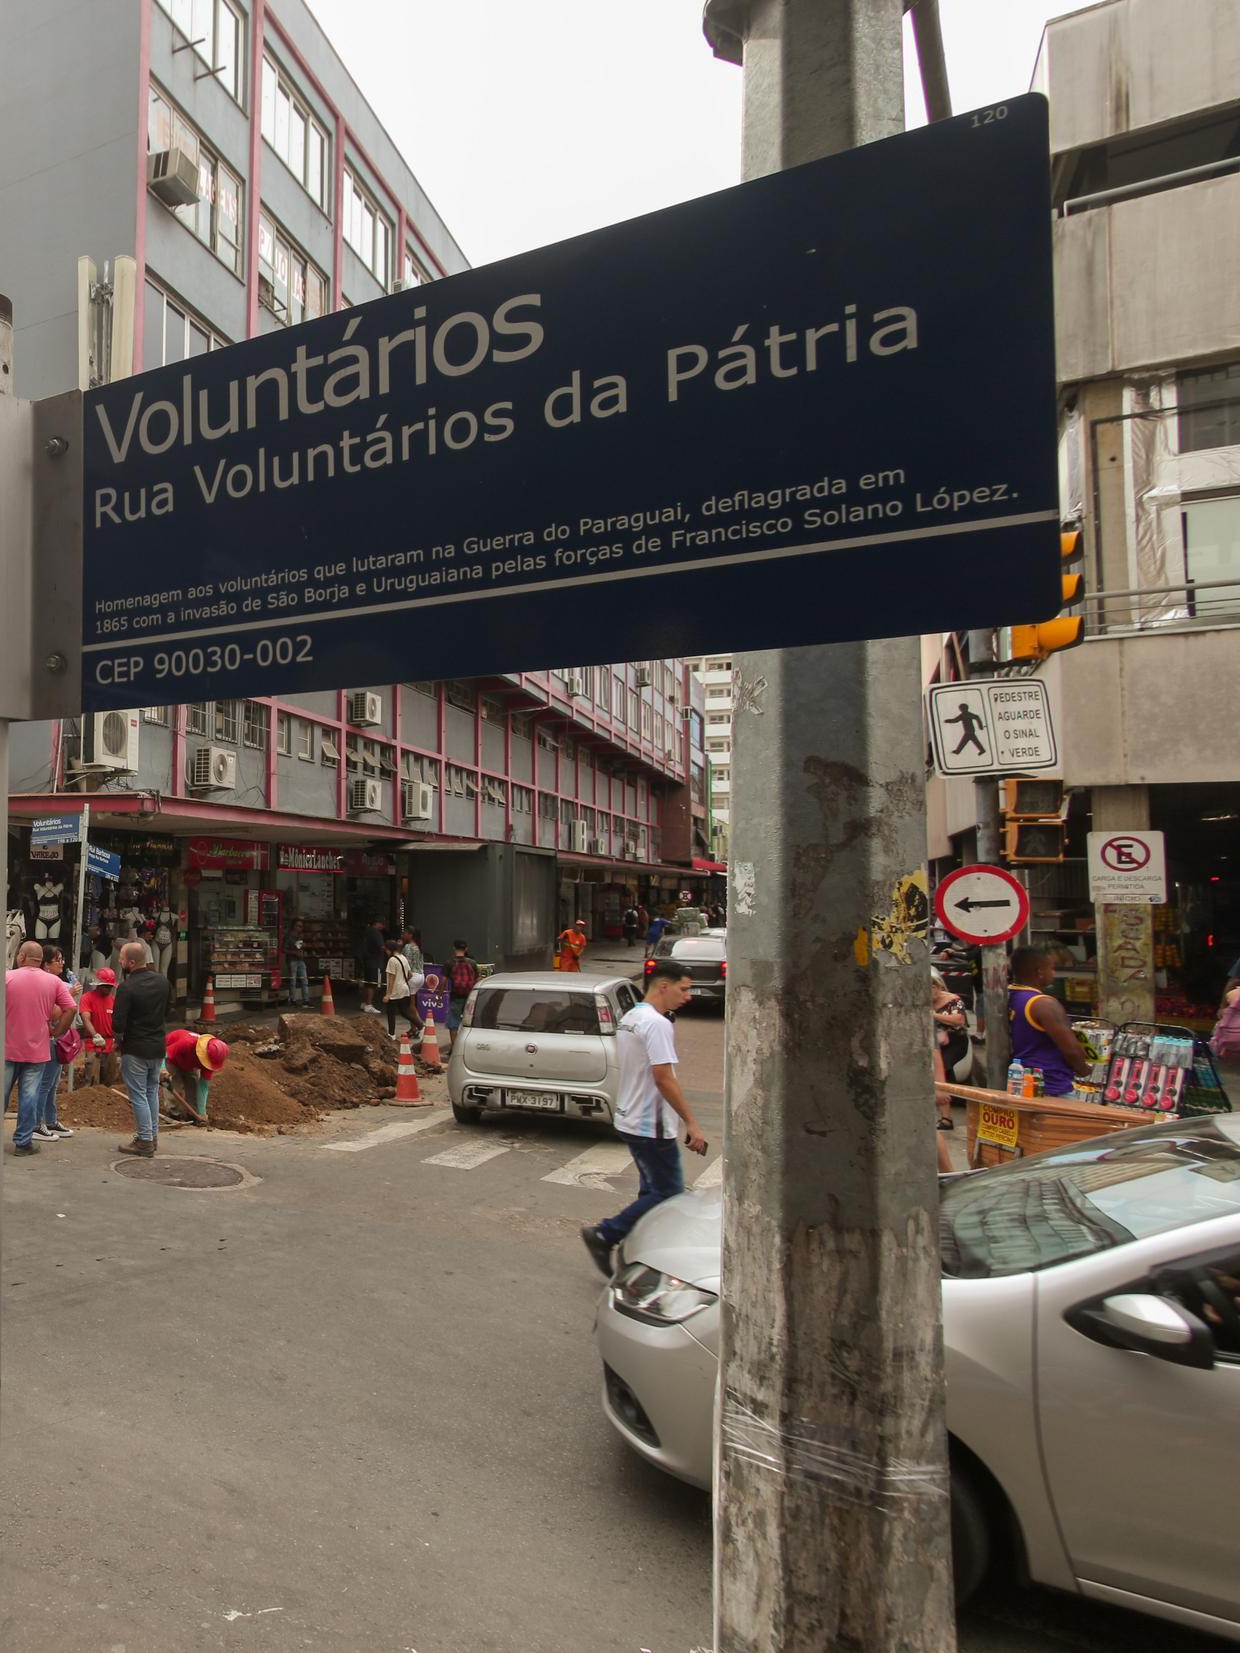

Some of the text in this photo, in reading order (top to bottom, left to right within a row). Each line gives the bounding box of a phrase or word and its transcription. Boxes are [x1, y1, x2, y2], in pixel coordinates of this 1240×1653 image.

[972, 106, 1008, 127] 120
[96, 294, 544, 463] Voluntários
[96, 304, 917, 528] Rua Voluntários da Pátria
[96, 470, 904, 613] Homenagem aos voluntários que lutaram na Guerra do Paraguai, deflagrada em
[96, 484, 1018, 633] 1865 com a invasão de São Borja e Uruguaiana pelas forças de Francisco Solano López.
[96, 635, 312, 684] CEP 90030-002
[994, 691, 1040, 702] PEDESTRE
[998, 709, 1041, 720] AGUARDE
[1004, 728, 1040, 739] O SINAL
[1009, 747, 1040, 757] VERDE
[33, 819, 61, 827] Voluntários
[983, 1112, 1014, 1130] OURO
